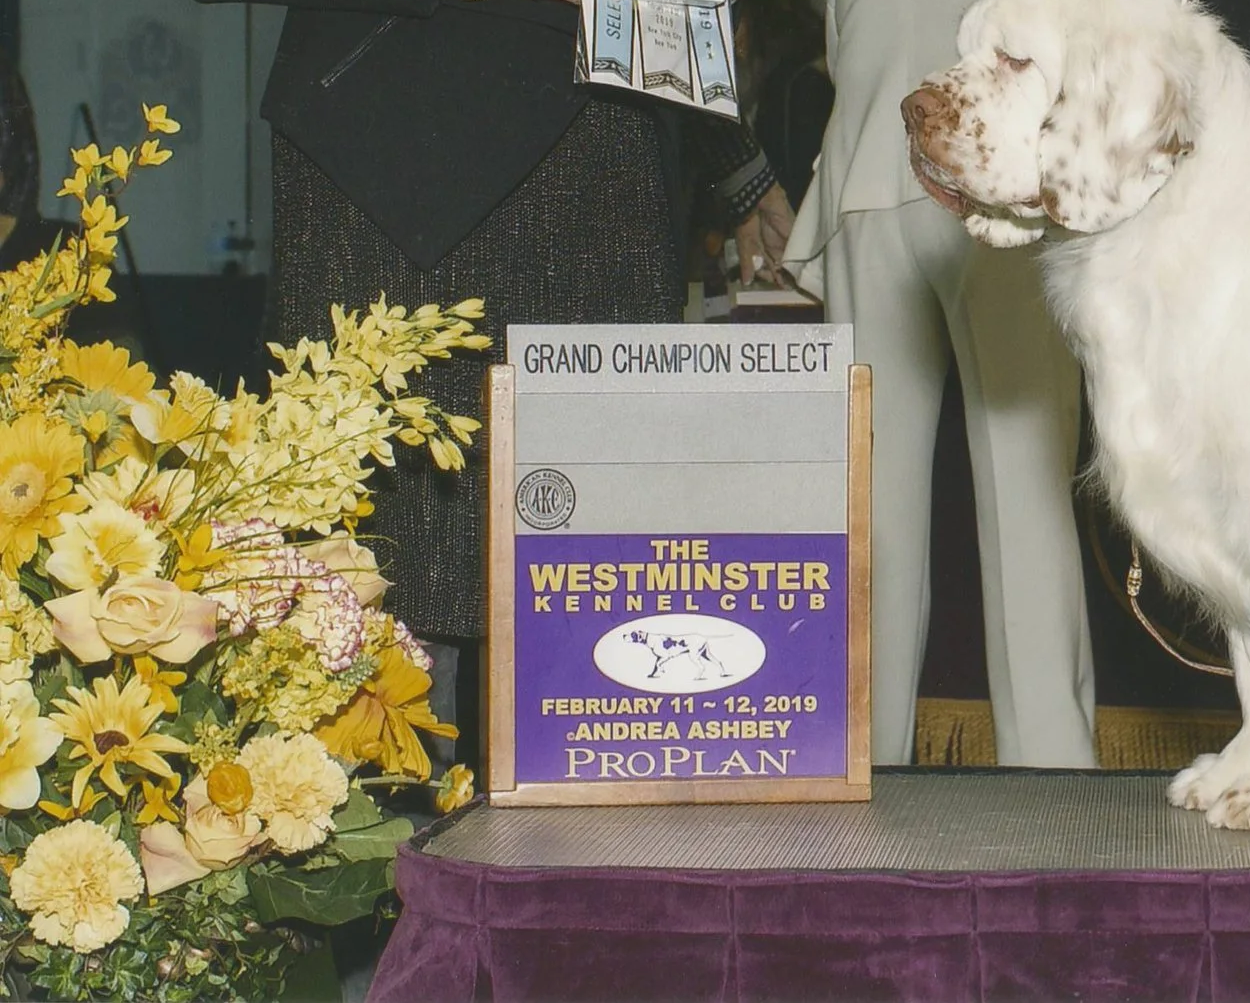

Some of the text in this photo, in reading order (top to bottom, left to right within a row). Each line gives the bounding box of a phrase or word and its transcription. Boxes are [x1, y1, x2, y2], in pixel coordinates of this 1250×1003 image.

[524, 342, 834, 374] GRAND CHAMPION SELECT
[531, 484, 559, 514] AKC
[650, 539, 710, 561] THE
[529, 561, 831, 593] WESTMINSTER
[533, 592, 827, 613] KENNEL CLUB
[541, 698, 662, 716] FEBRUARY
[670, 697, 695, 715] 11
[723, 697, 758, 718] 12,
[764, 695, 818, 714] 2019
[687, 719, 793, 740] ASHBEY
